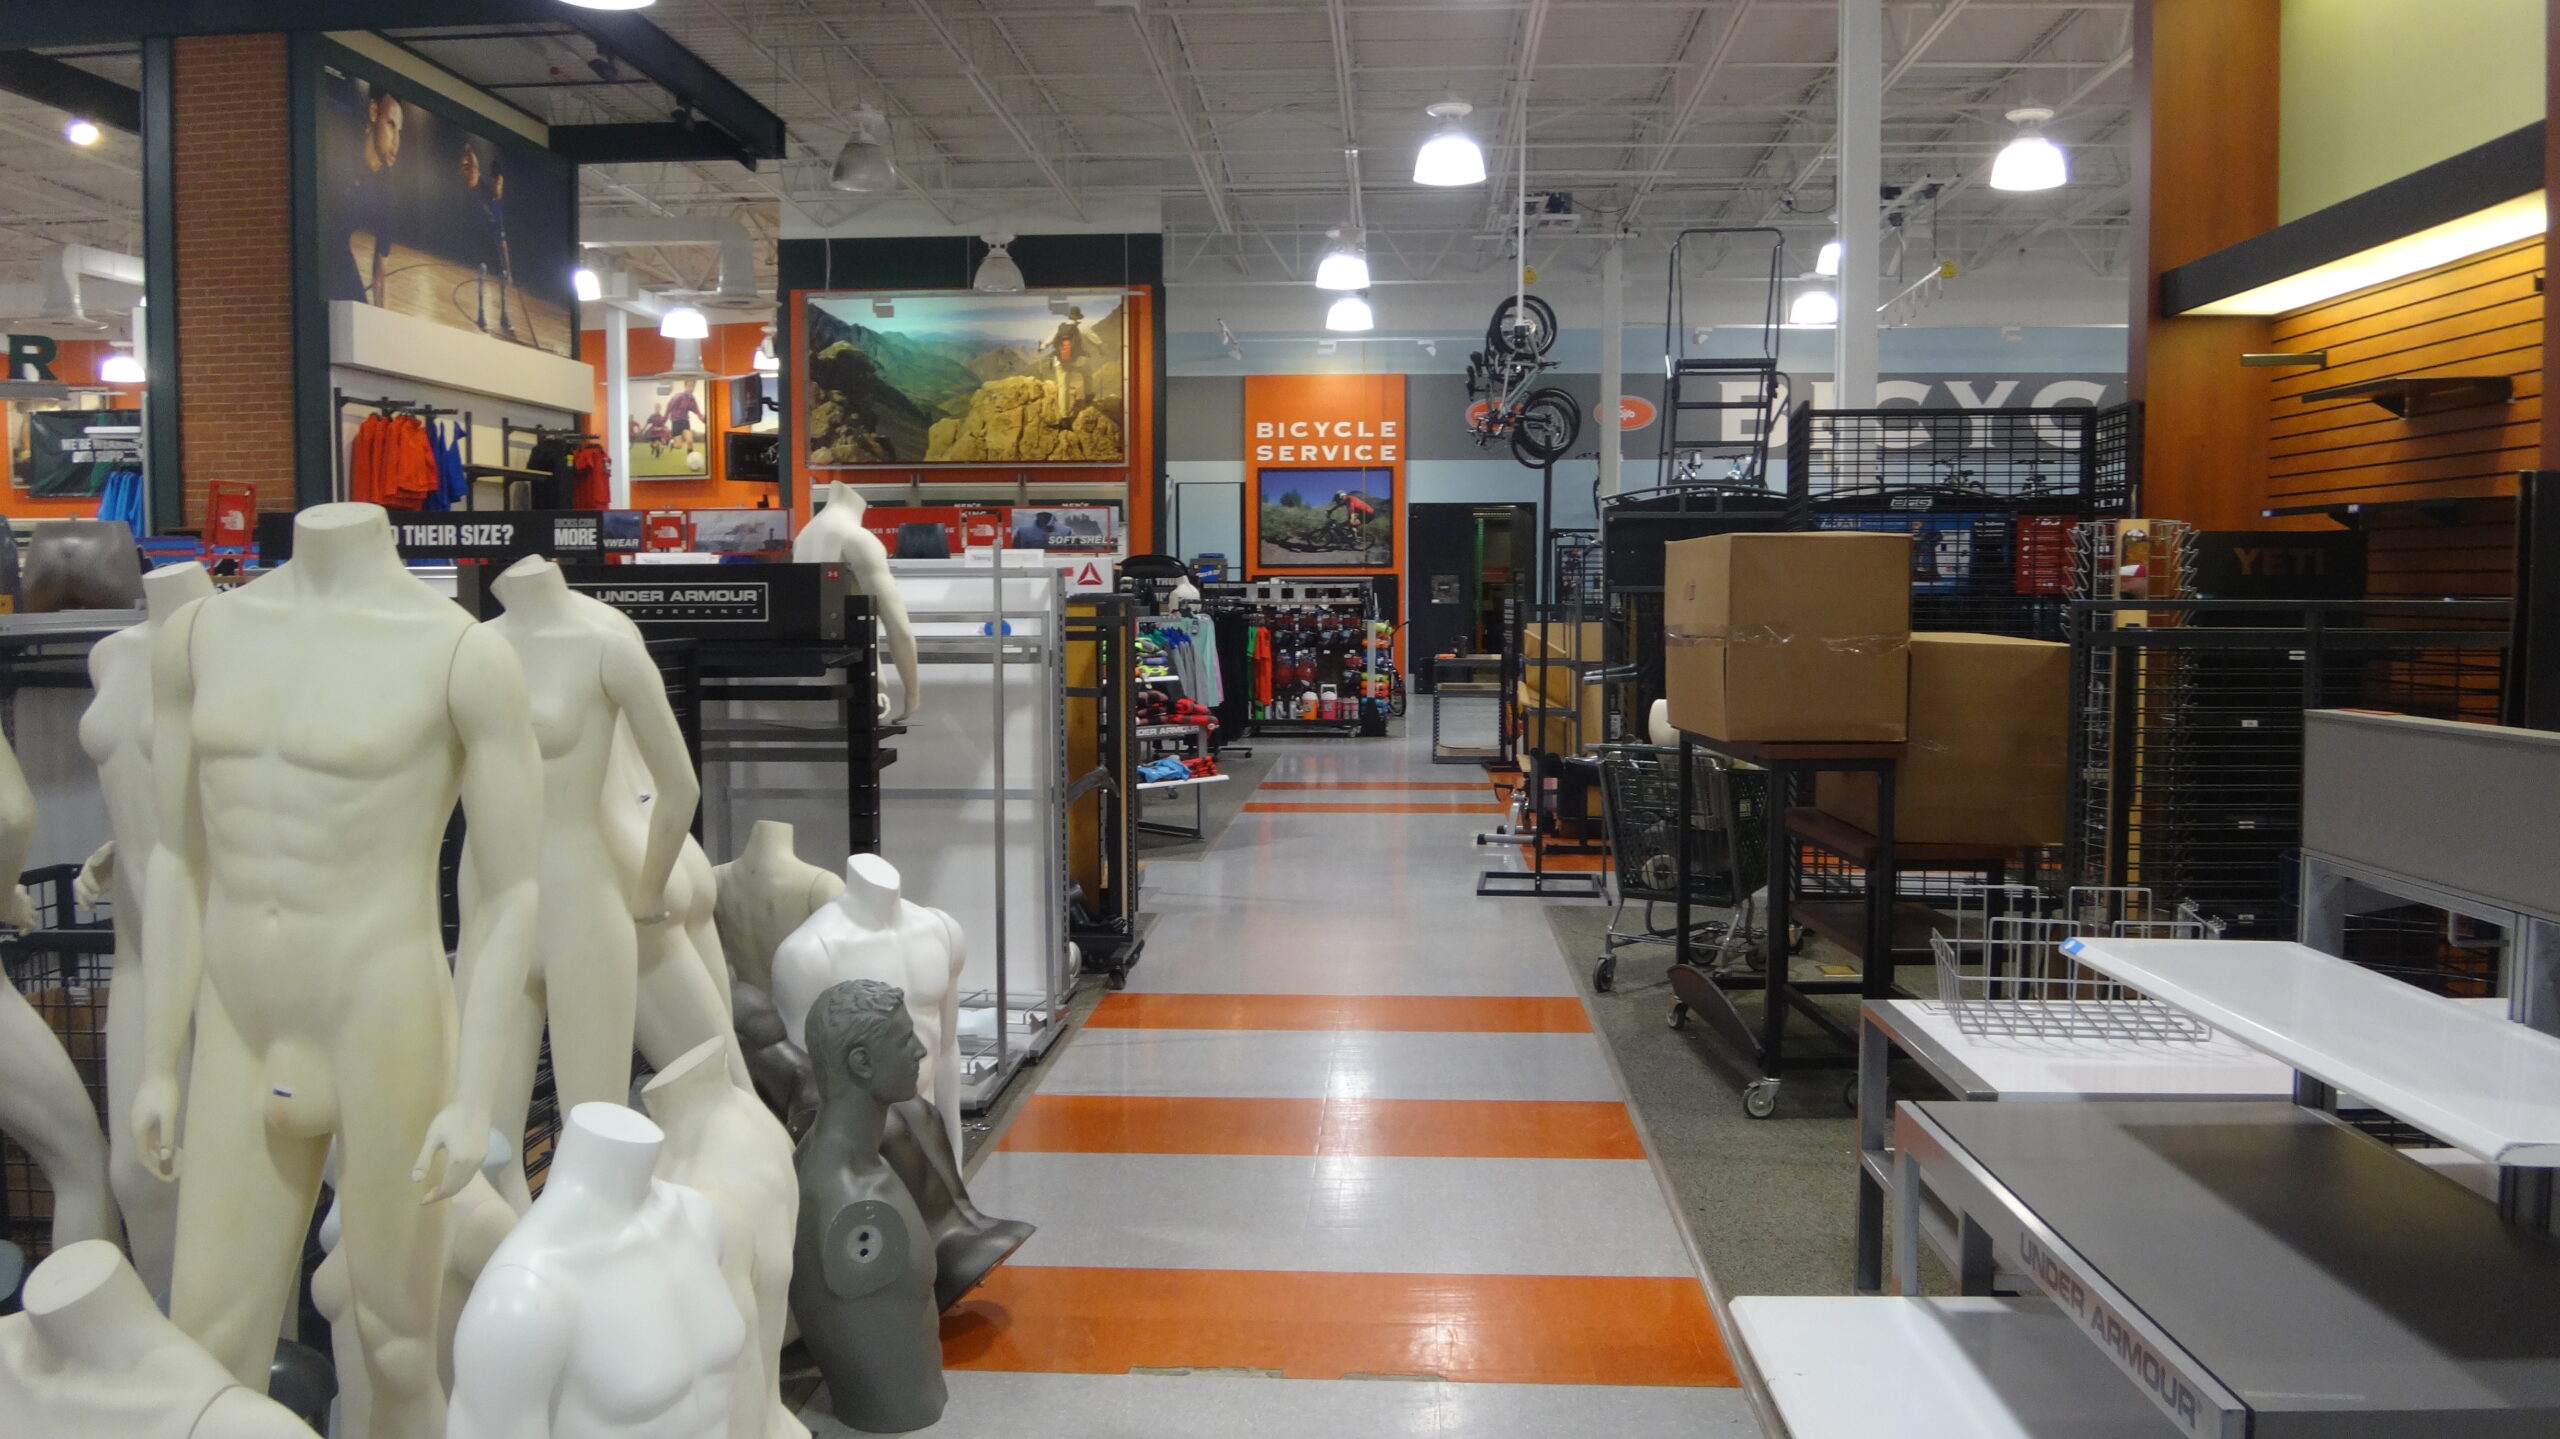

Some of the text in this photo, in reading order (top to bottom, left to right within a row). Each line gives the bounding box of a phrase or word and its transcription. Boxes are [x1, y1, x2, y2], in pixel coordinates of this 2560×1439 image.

[1255, 421, 1397, 438] BICYCLE
[1255, 444, 1397, 461] SERVICE
[403, 524, 458, 546] THEIR
[460, 524, 514, 546] SIZE?
[554, 528, 597, 546] MORE
[1048, 535, 1077, 545] SOFT
[2233, 547, 2325, 575] YETI
[596, 589, 758, 603] UNDER ARMOUR
[1159, 724, 1200, 735] ARMOUR
[2020, 1231, 2196, 1430] UNDER ARMOUR
